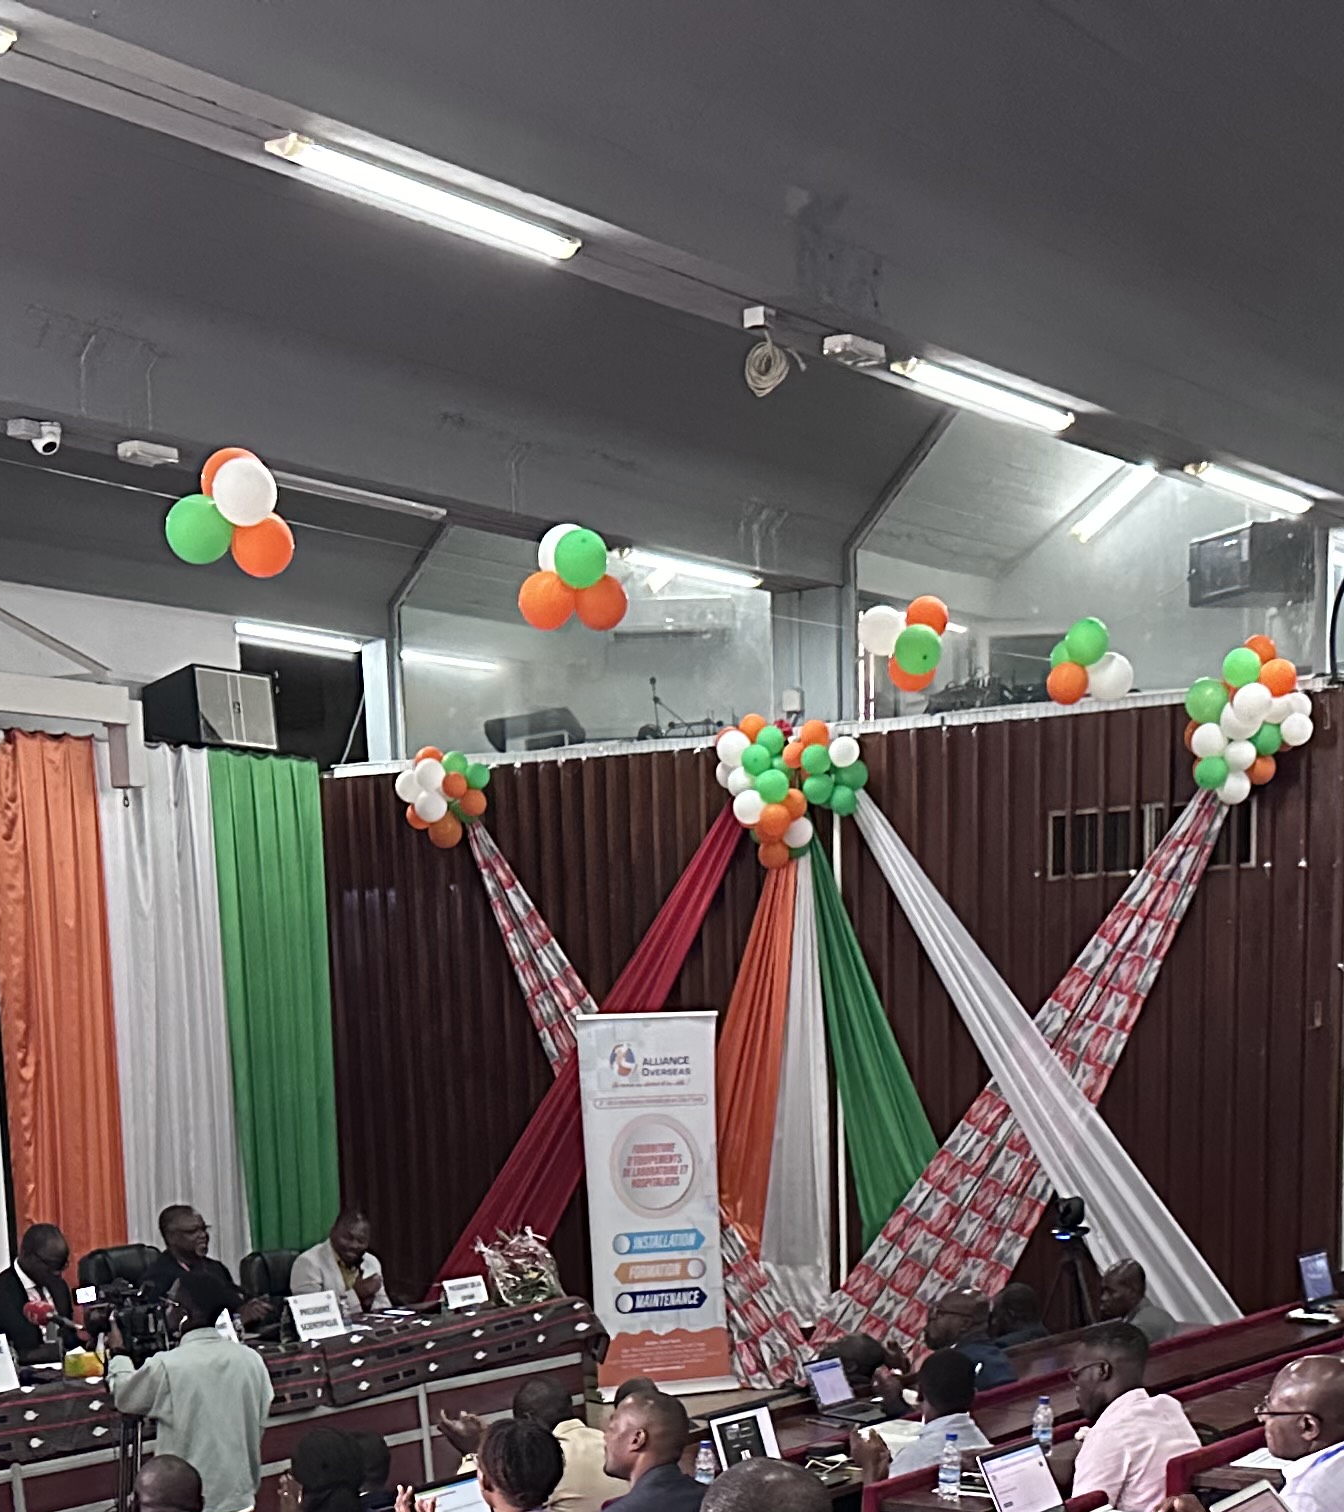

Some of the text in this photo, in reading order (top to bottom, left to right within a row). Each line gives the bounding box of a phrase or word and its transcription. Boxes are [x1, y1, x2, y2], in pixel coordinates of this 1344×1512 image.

[642, 1056, 690, 1066] ALLIANCE
[633, 1232, 696, 1249] INSTALLATION
[635, 1290, 700, 1308] MAINTENANCE
